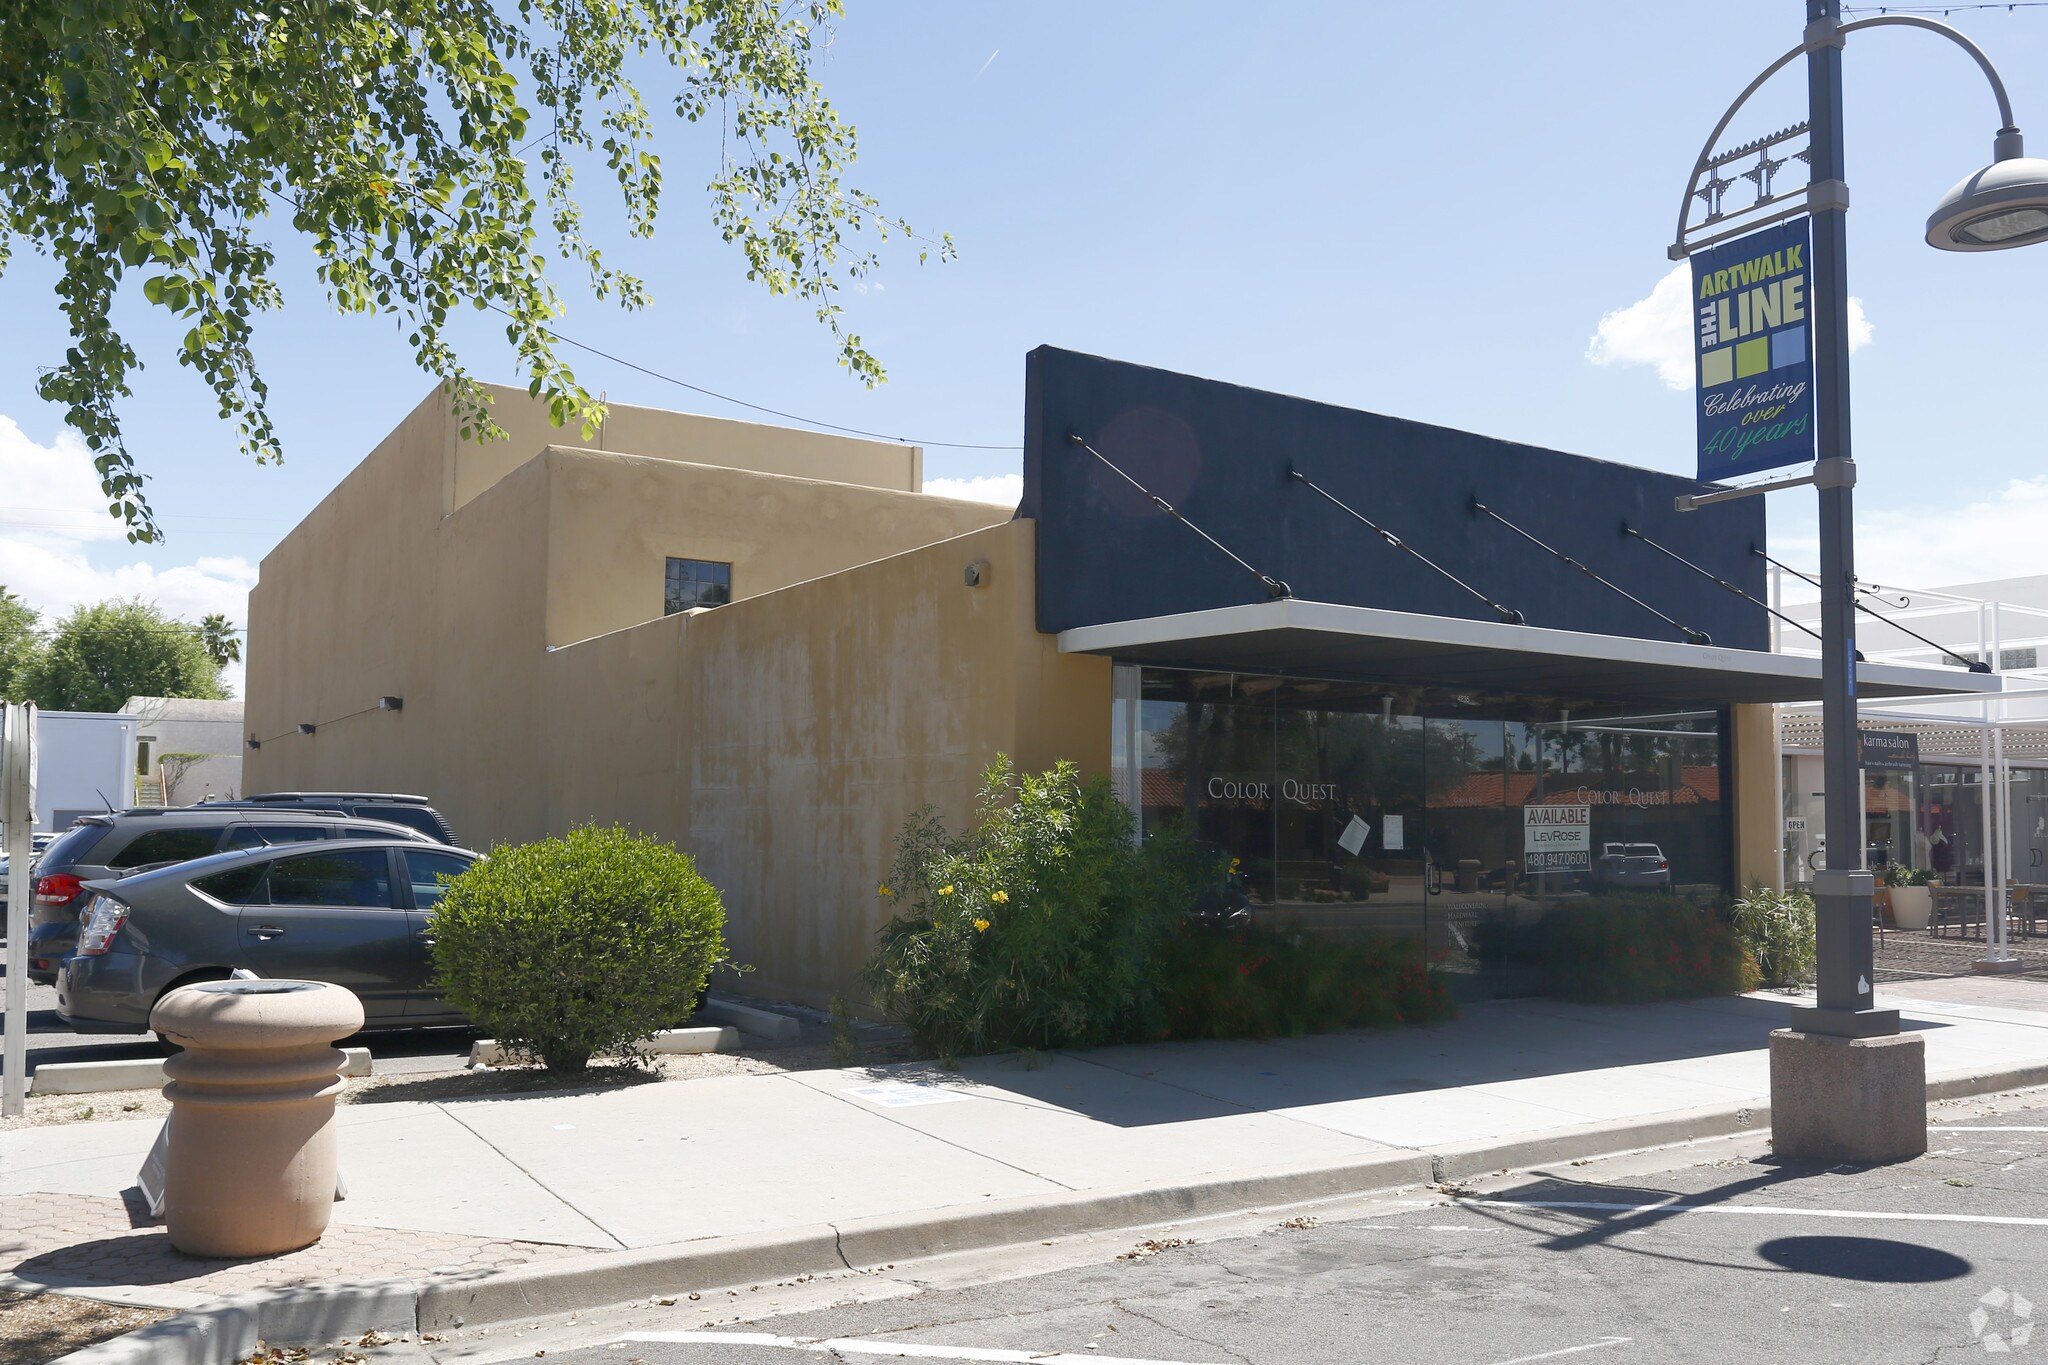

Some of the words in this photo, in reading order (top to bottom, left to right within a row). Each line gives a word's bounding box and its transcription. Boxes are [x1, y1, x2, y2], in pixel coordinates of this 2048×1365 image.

[1700, 244, 1804, 299] ARTWALK
[1718, 274, 1805, 343] LINE
[1700, 301, 1718, 349] THE
[1703, 381, 1806, 417] Celebrating
[1741, 403, 1786, 426] over
[1703, 426, 1738, 454] 40
[1731, 413, 1808, 460] years
[1208, 777, 1271, 799] COLOR
[1282, 778, 1337, 805] QUEST
[1577, 785, 1620, 805] COLOR
[1628, 787, 1668, 809] QUEST
[1527, 808, 1587, 825] AVAILABLE
[1788, 820, 1805, 830] OPEN
[1527, 852, 1588, 867] 480.947.0600
